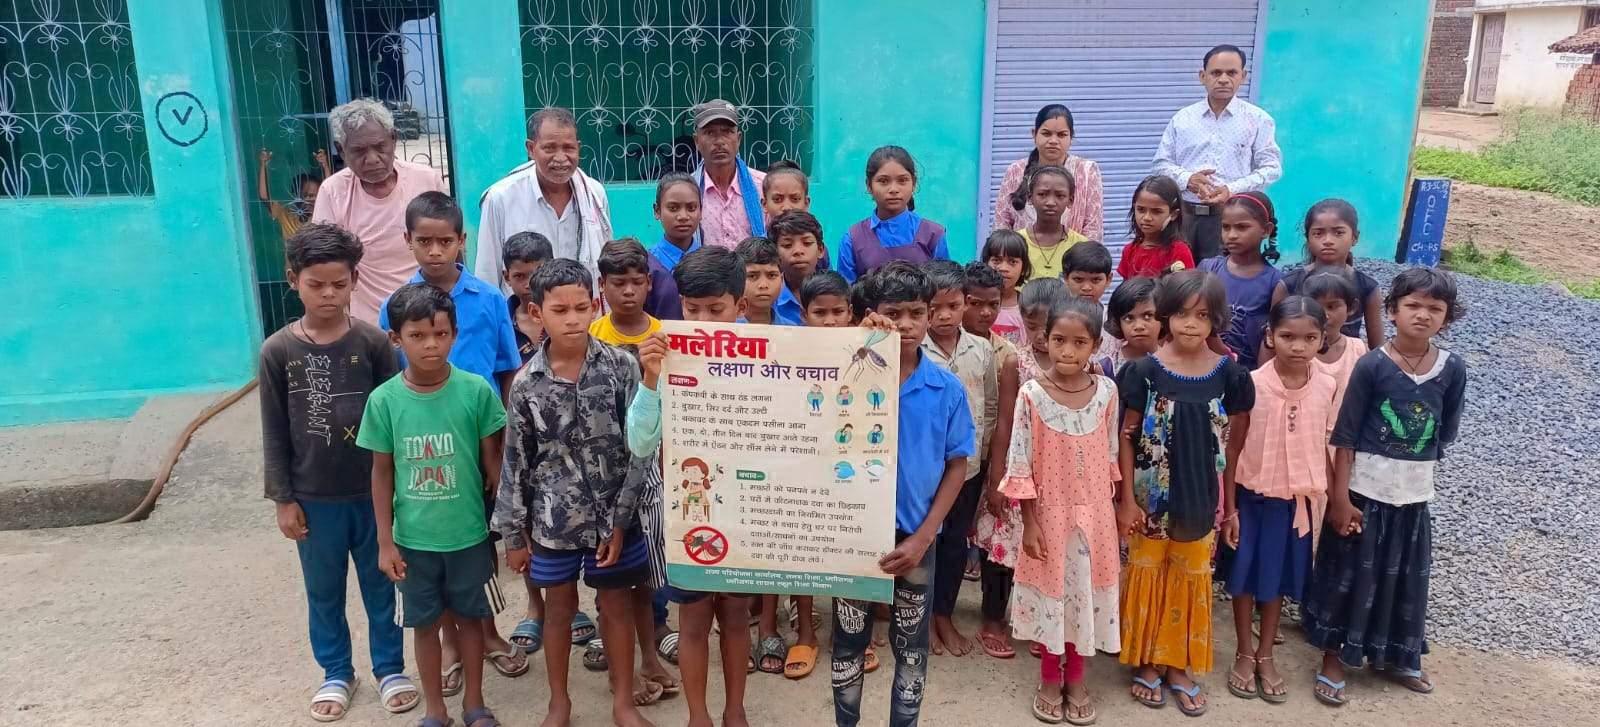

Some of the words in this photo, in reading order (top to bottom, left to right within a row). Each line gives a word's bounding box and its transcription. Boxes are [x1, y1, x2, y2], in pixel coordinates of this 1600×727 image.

[667, 328, 769, 359] मलेरिया
[708, 362, 755, 378] लक्षण
[760, 360, 791, 379] और
[796, 366, 839, 381] बचाव
[304, 353, 333, 447] ELEGANT
[711, 391, 718, 399] के
[706, 403, 719, 411] सिर
[723, 405, 732, 413] दर्द
[735, 406, 748, 414] और
[752, 406, 768, 414] उल्टी
[763, 419, 785, 428] पसीना
[713, 429, 726, 437] तीन
[729, 430, 741, 438] दिन
[760, 433, 780, 441] बुखार
[403, 432, 455, 459] TOKYO
[682, 439, 699, 447] शरीर
[730, 442, 743, 451] और
[408, 465, 451, 491] JAPAN
[845, 547, 854, 555] की
[901, 608, 917, 618] BIG
